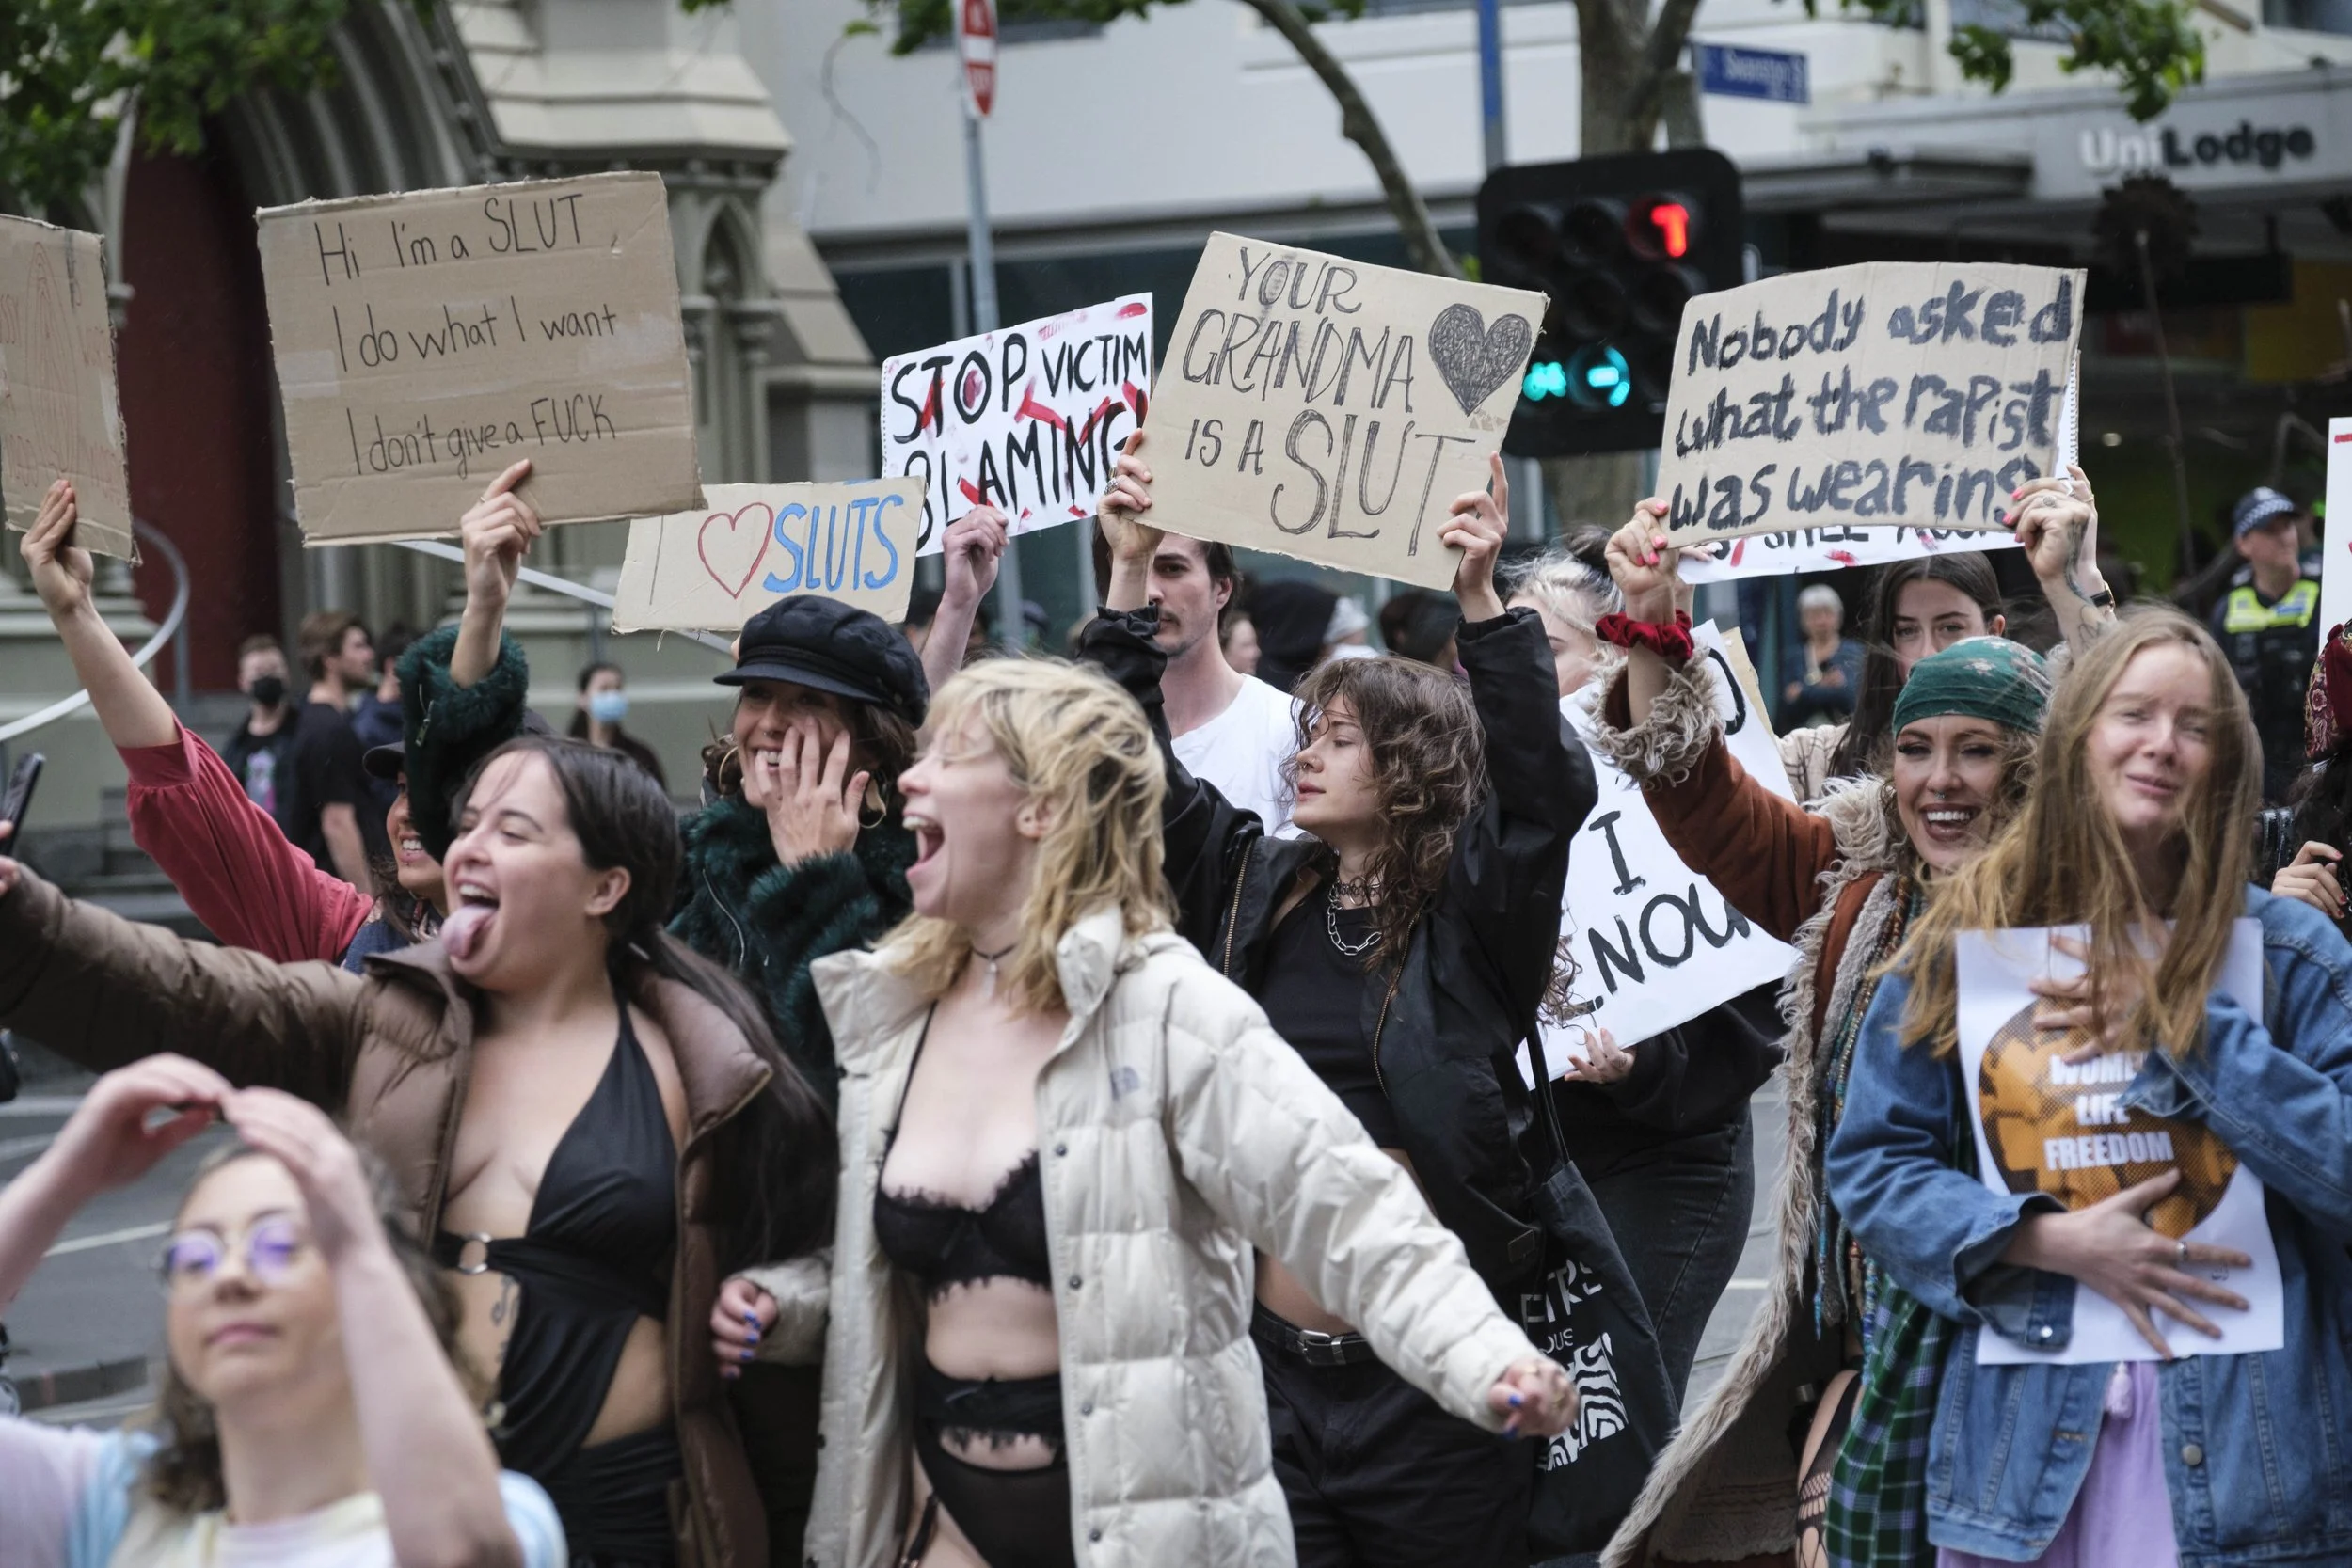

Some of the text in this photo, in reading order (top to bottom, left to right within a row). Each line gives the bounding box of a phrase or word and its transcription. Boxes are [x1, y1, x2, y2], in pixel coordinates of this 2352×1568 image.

[2080, 120, 2316, 171] UniLodge
[314, 193, 582, 286] Hi I'm a SLUT
[1238, 246, 1362, 315] YOUR
[333, 294, 617, 372] I do what I want
[1182, 309, 1414, 414] GRANDMA
[1687, 274, 2074, 377] Nobody asked
[890, 331, 1147, 445] STOP VICTIM
[1675, 372, 1803, 458] what
[345, 393, 616, 481] I don't give a FUCK
[1184, 408, 1476, 557] IS A SLUT
[1668, 462, 1778, 531] was
[762, 494, 904, 594] SLUTS
[1588, 810, 1646, 895] I
[2043, 1131, 2175, 1172] FREEDOM
[2076, 1093, 2131, 1126] LIFE
